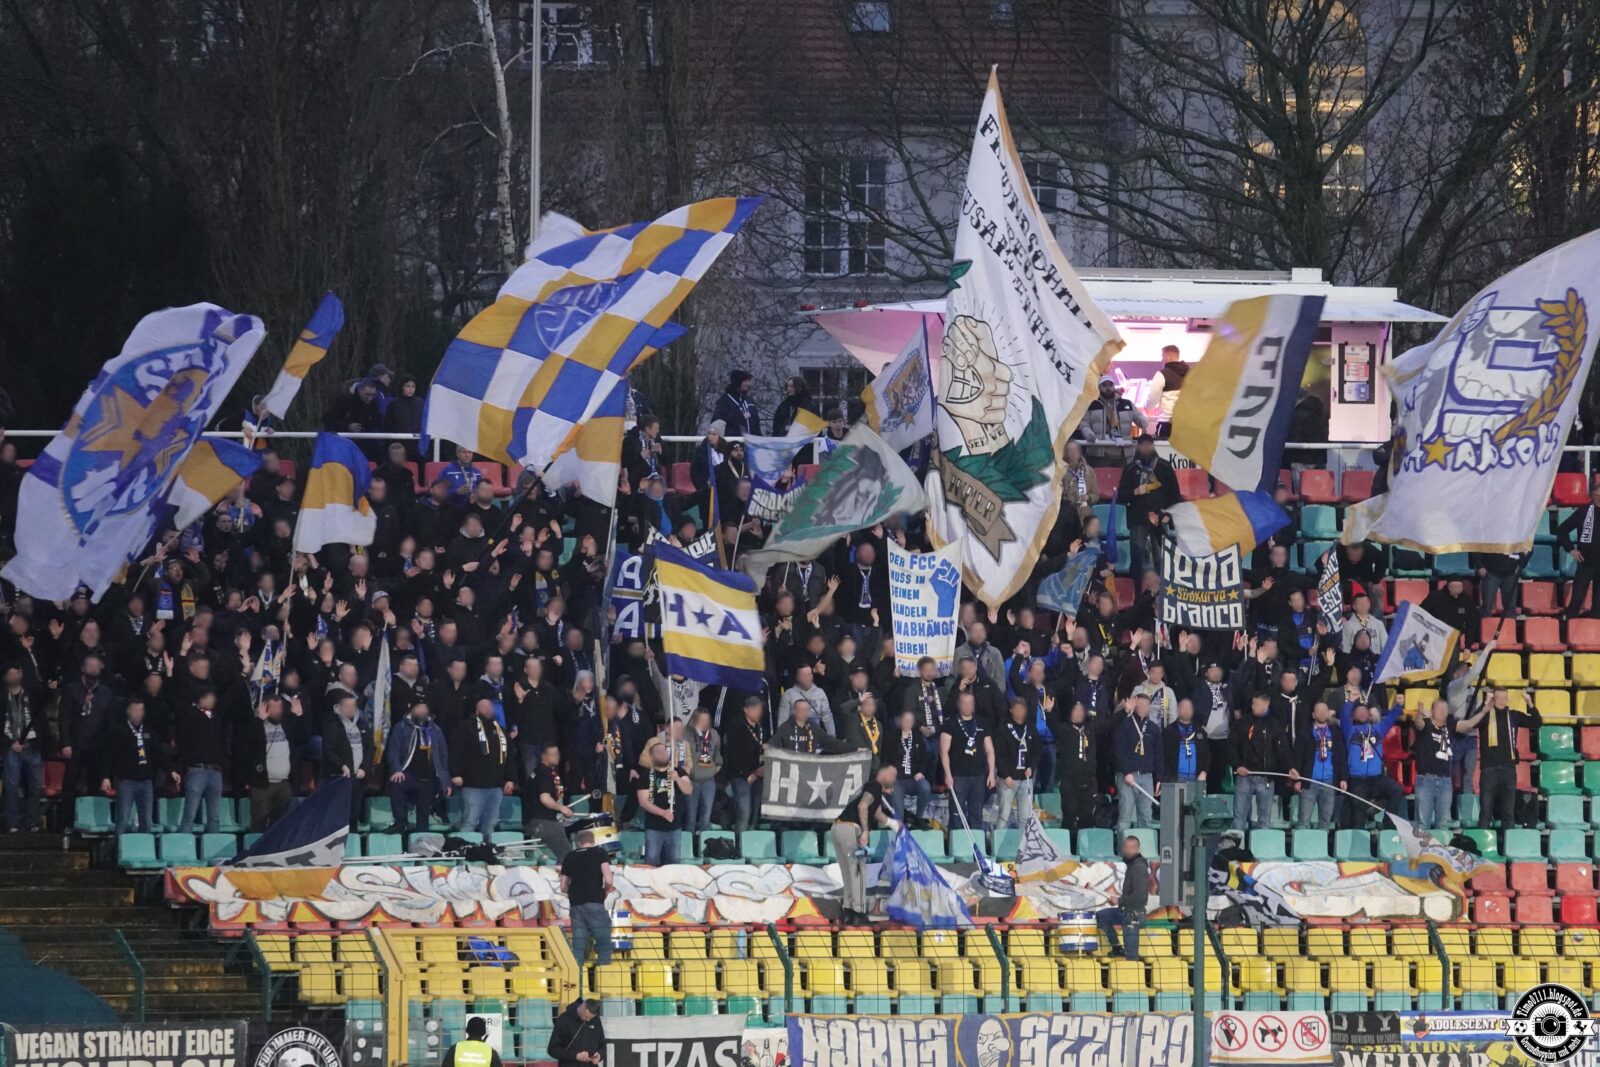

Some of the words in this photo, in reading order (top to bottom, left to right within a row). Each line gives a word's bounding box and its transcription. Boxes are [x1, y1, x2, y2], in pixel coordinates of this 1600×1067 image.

[889, 552, 905, 567] DER
[909, 554, 936, 570] FCC
[915, 575, 926, 584] IN
[1163, 599, 1243, 628] branco
[895, 641, 928, 655] LEIBEN!
[1428, 1018, 1496, 1031] ADOLESCENT
[14, 1031, 80, 1060] VEGAN
[83, 1030, 182, 1058] STRAIGHT
[185, 1028, 235, 1056] EDGE
[272, 1030, 306, 1051] IMMER
[307, 1032, 326, 1049] MIT
